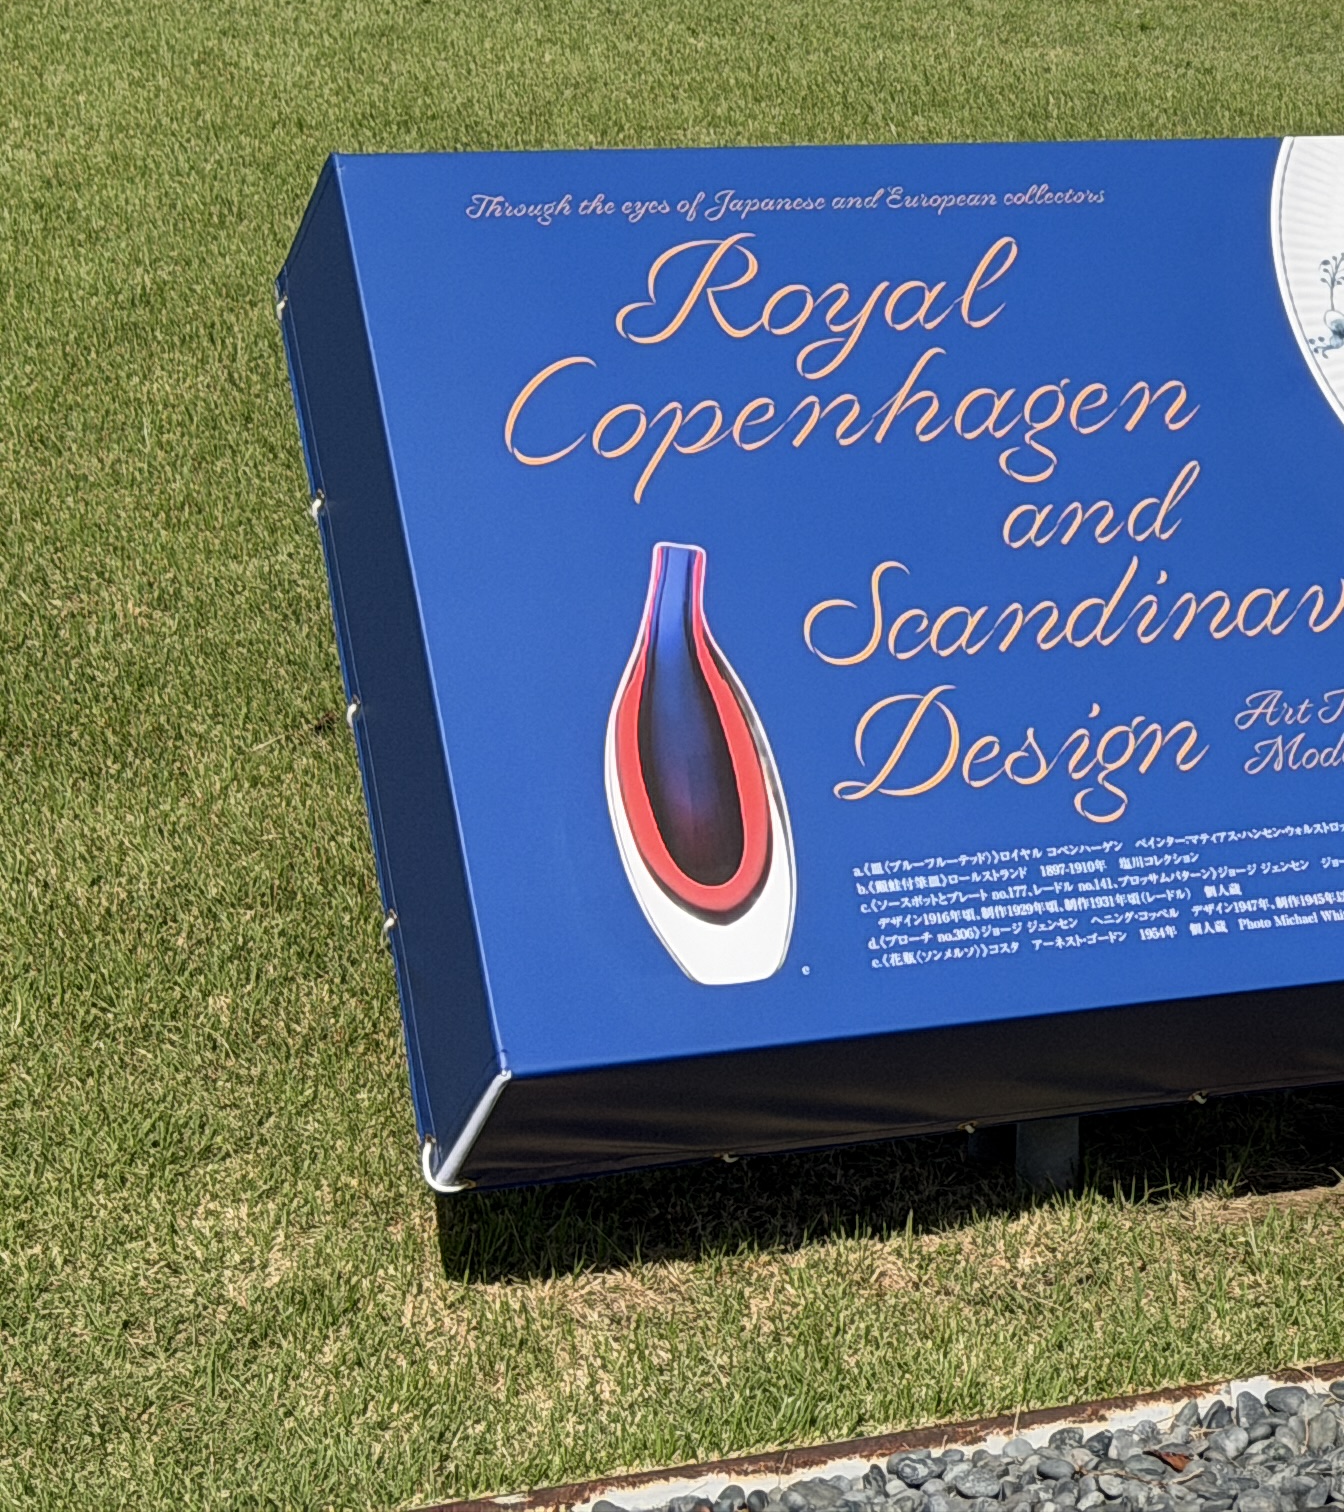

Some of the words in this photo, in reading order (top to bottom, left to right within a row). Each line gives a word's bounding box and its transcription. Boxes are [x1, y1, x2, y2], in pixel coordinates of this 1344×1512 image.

[466, 195, 572, 225] Through
[579, 194, 614, 214] the
[677, 192, 705, 221] of
[704, 190, 824, 221] Japanese
[832, 189, 884, 208] and
[887, 187, 996, 215] European
[1004, 184, 1103, 205] collectors
[616, 232, 1017, 379] Royal
[504, 347, 1200, 504] Copenhagen
[1001, 460, 1202, 548] and
[1234, 688, 1314, 730] Art
[833, 684, 1210, 824] Design
[1238, 918, 1271, 930] Photo
[1273, 912, 1318, 926] Michael
